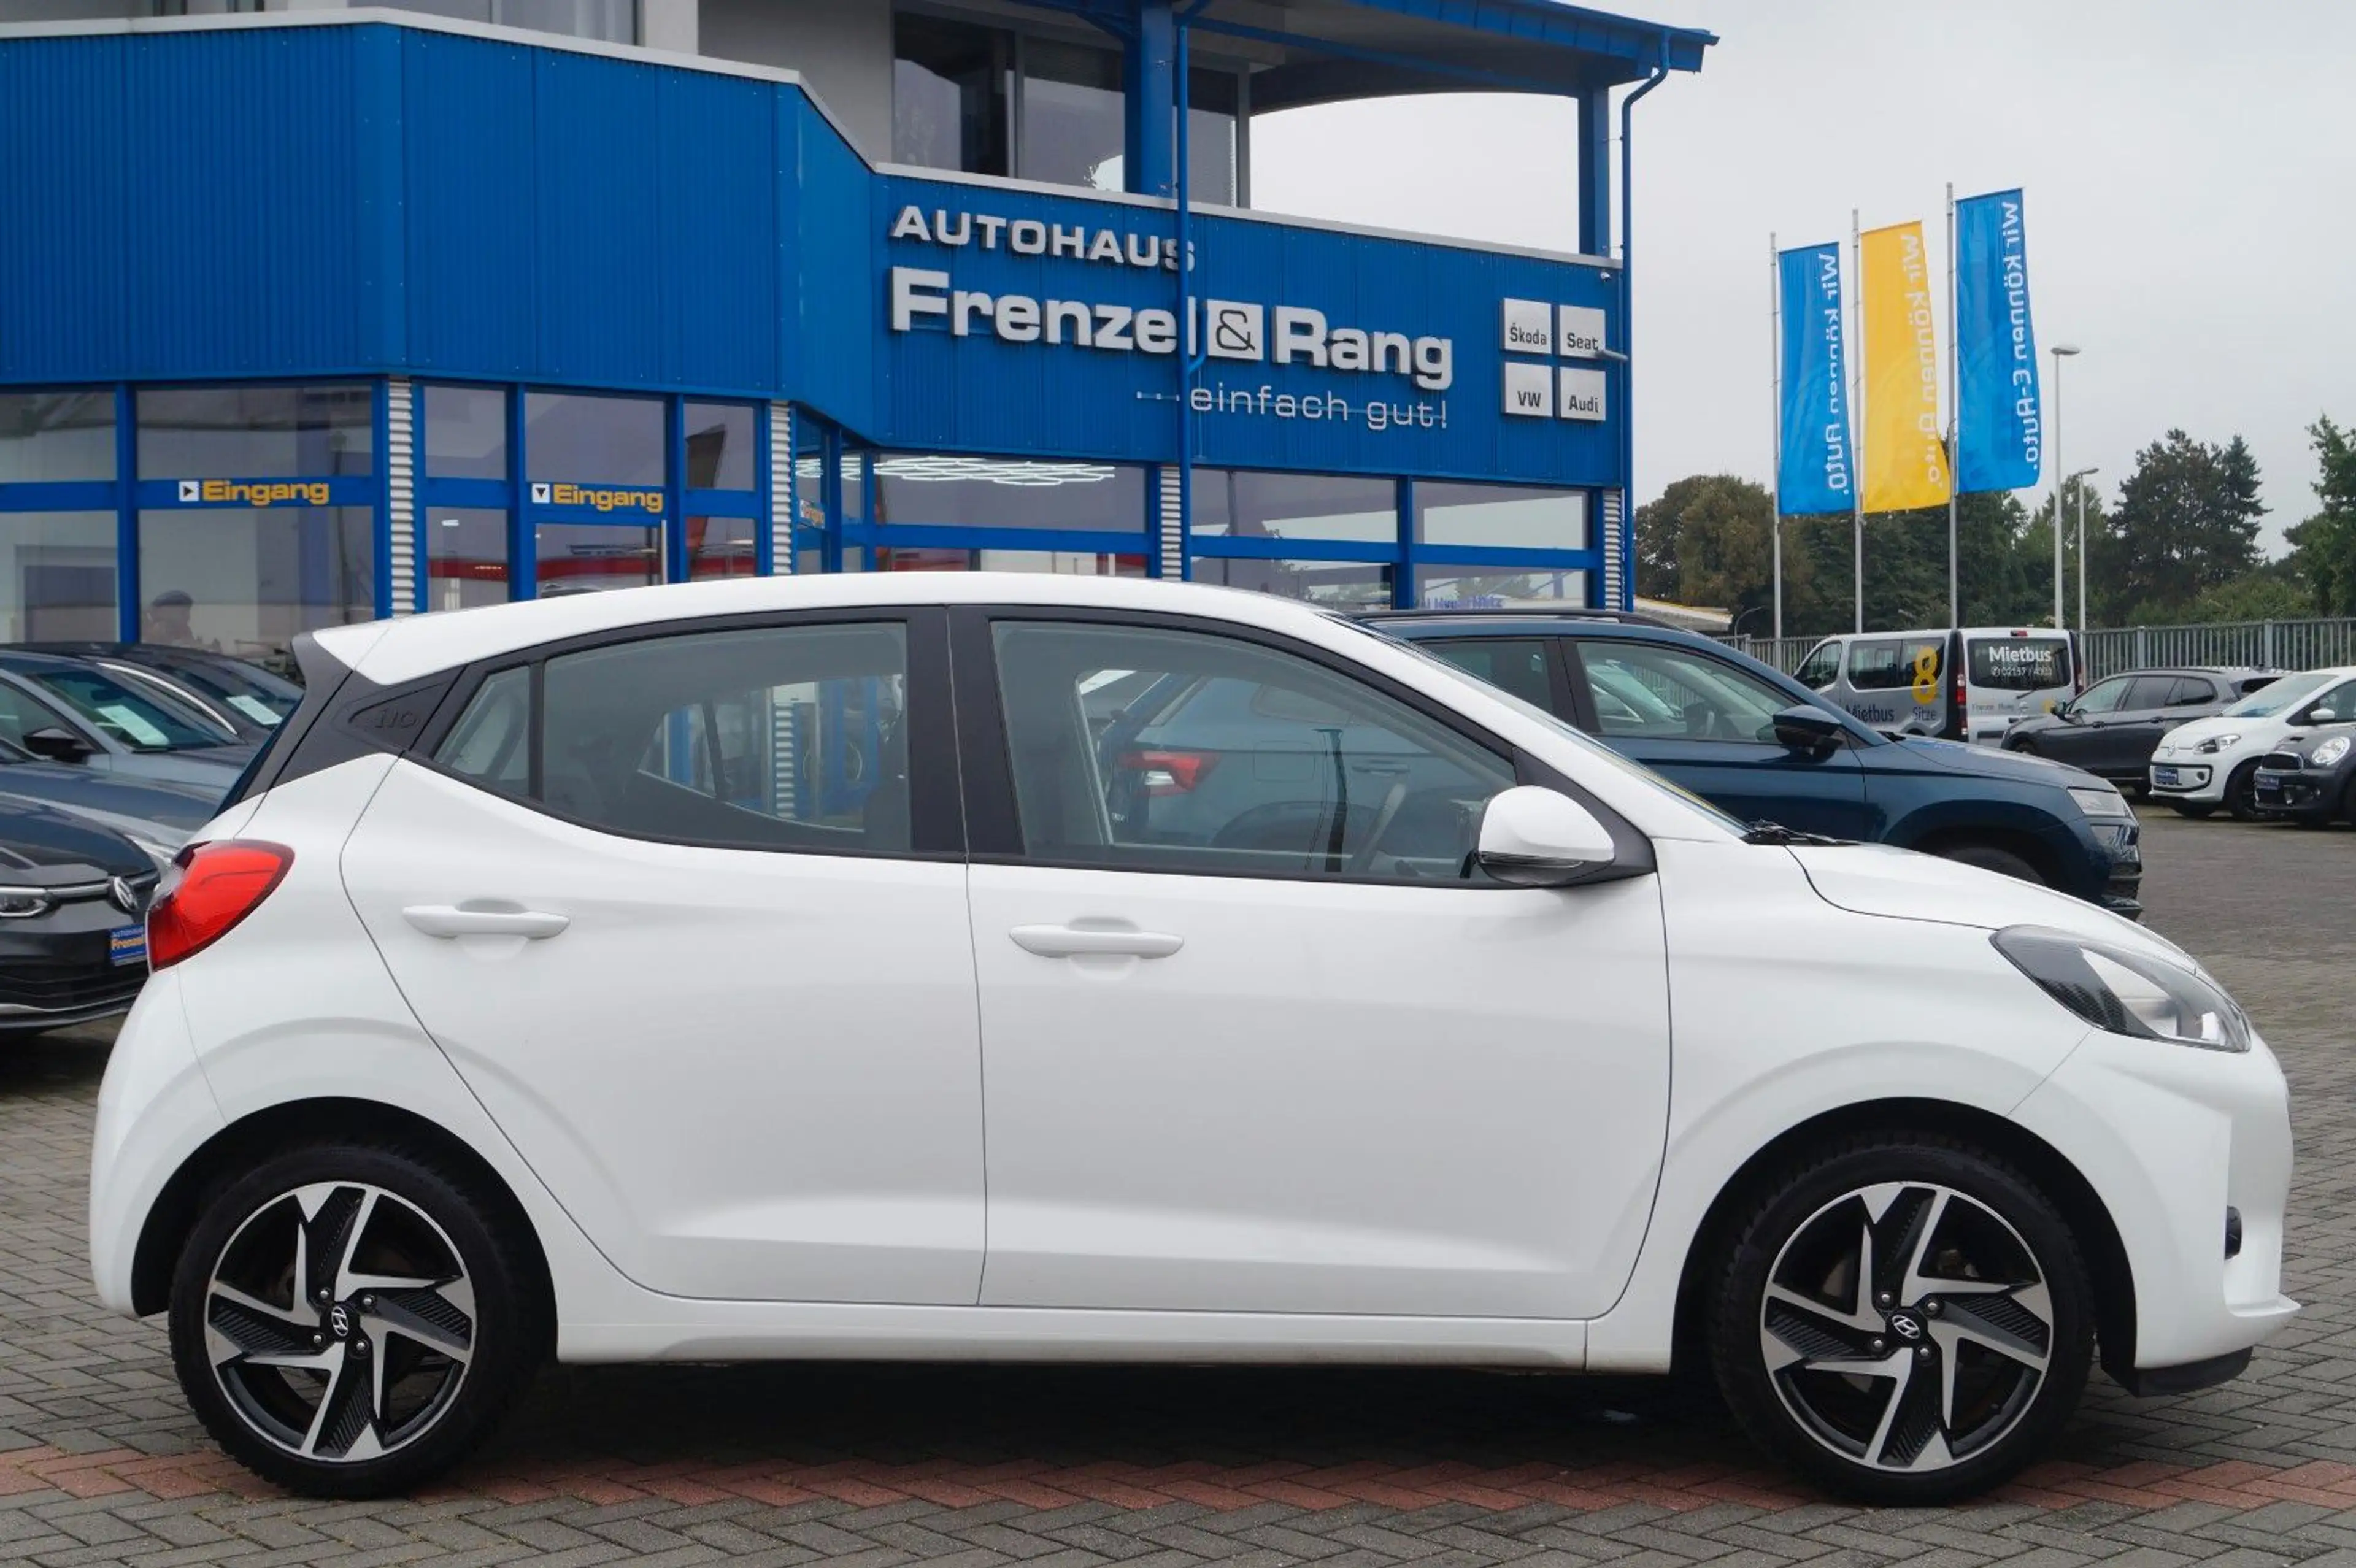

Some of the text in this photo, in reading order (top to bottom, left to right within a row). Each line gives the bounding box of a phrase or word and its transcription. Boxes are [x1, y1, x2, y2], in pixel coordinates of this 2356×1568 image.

[891, 206, 1195, 272] AUTOHAUS
[891, 266, 1453, 390] Frenzel & Rang
[1567, 332, 1599, 350] Seat
[1517, 390, 1541, 408] VW
[1569, 394, 1599, 413] Audi
[1367, 400, 1447, 430] gut!
[202, 480, 329, 506] Eingang
[553, 484, 663, 512] Eingang
[1988, 646, 2052, 663] Mietbus
[1912, 706, 1937, 721] Sitze
